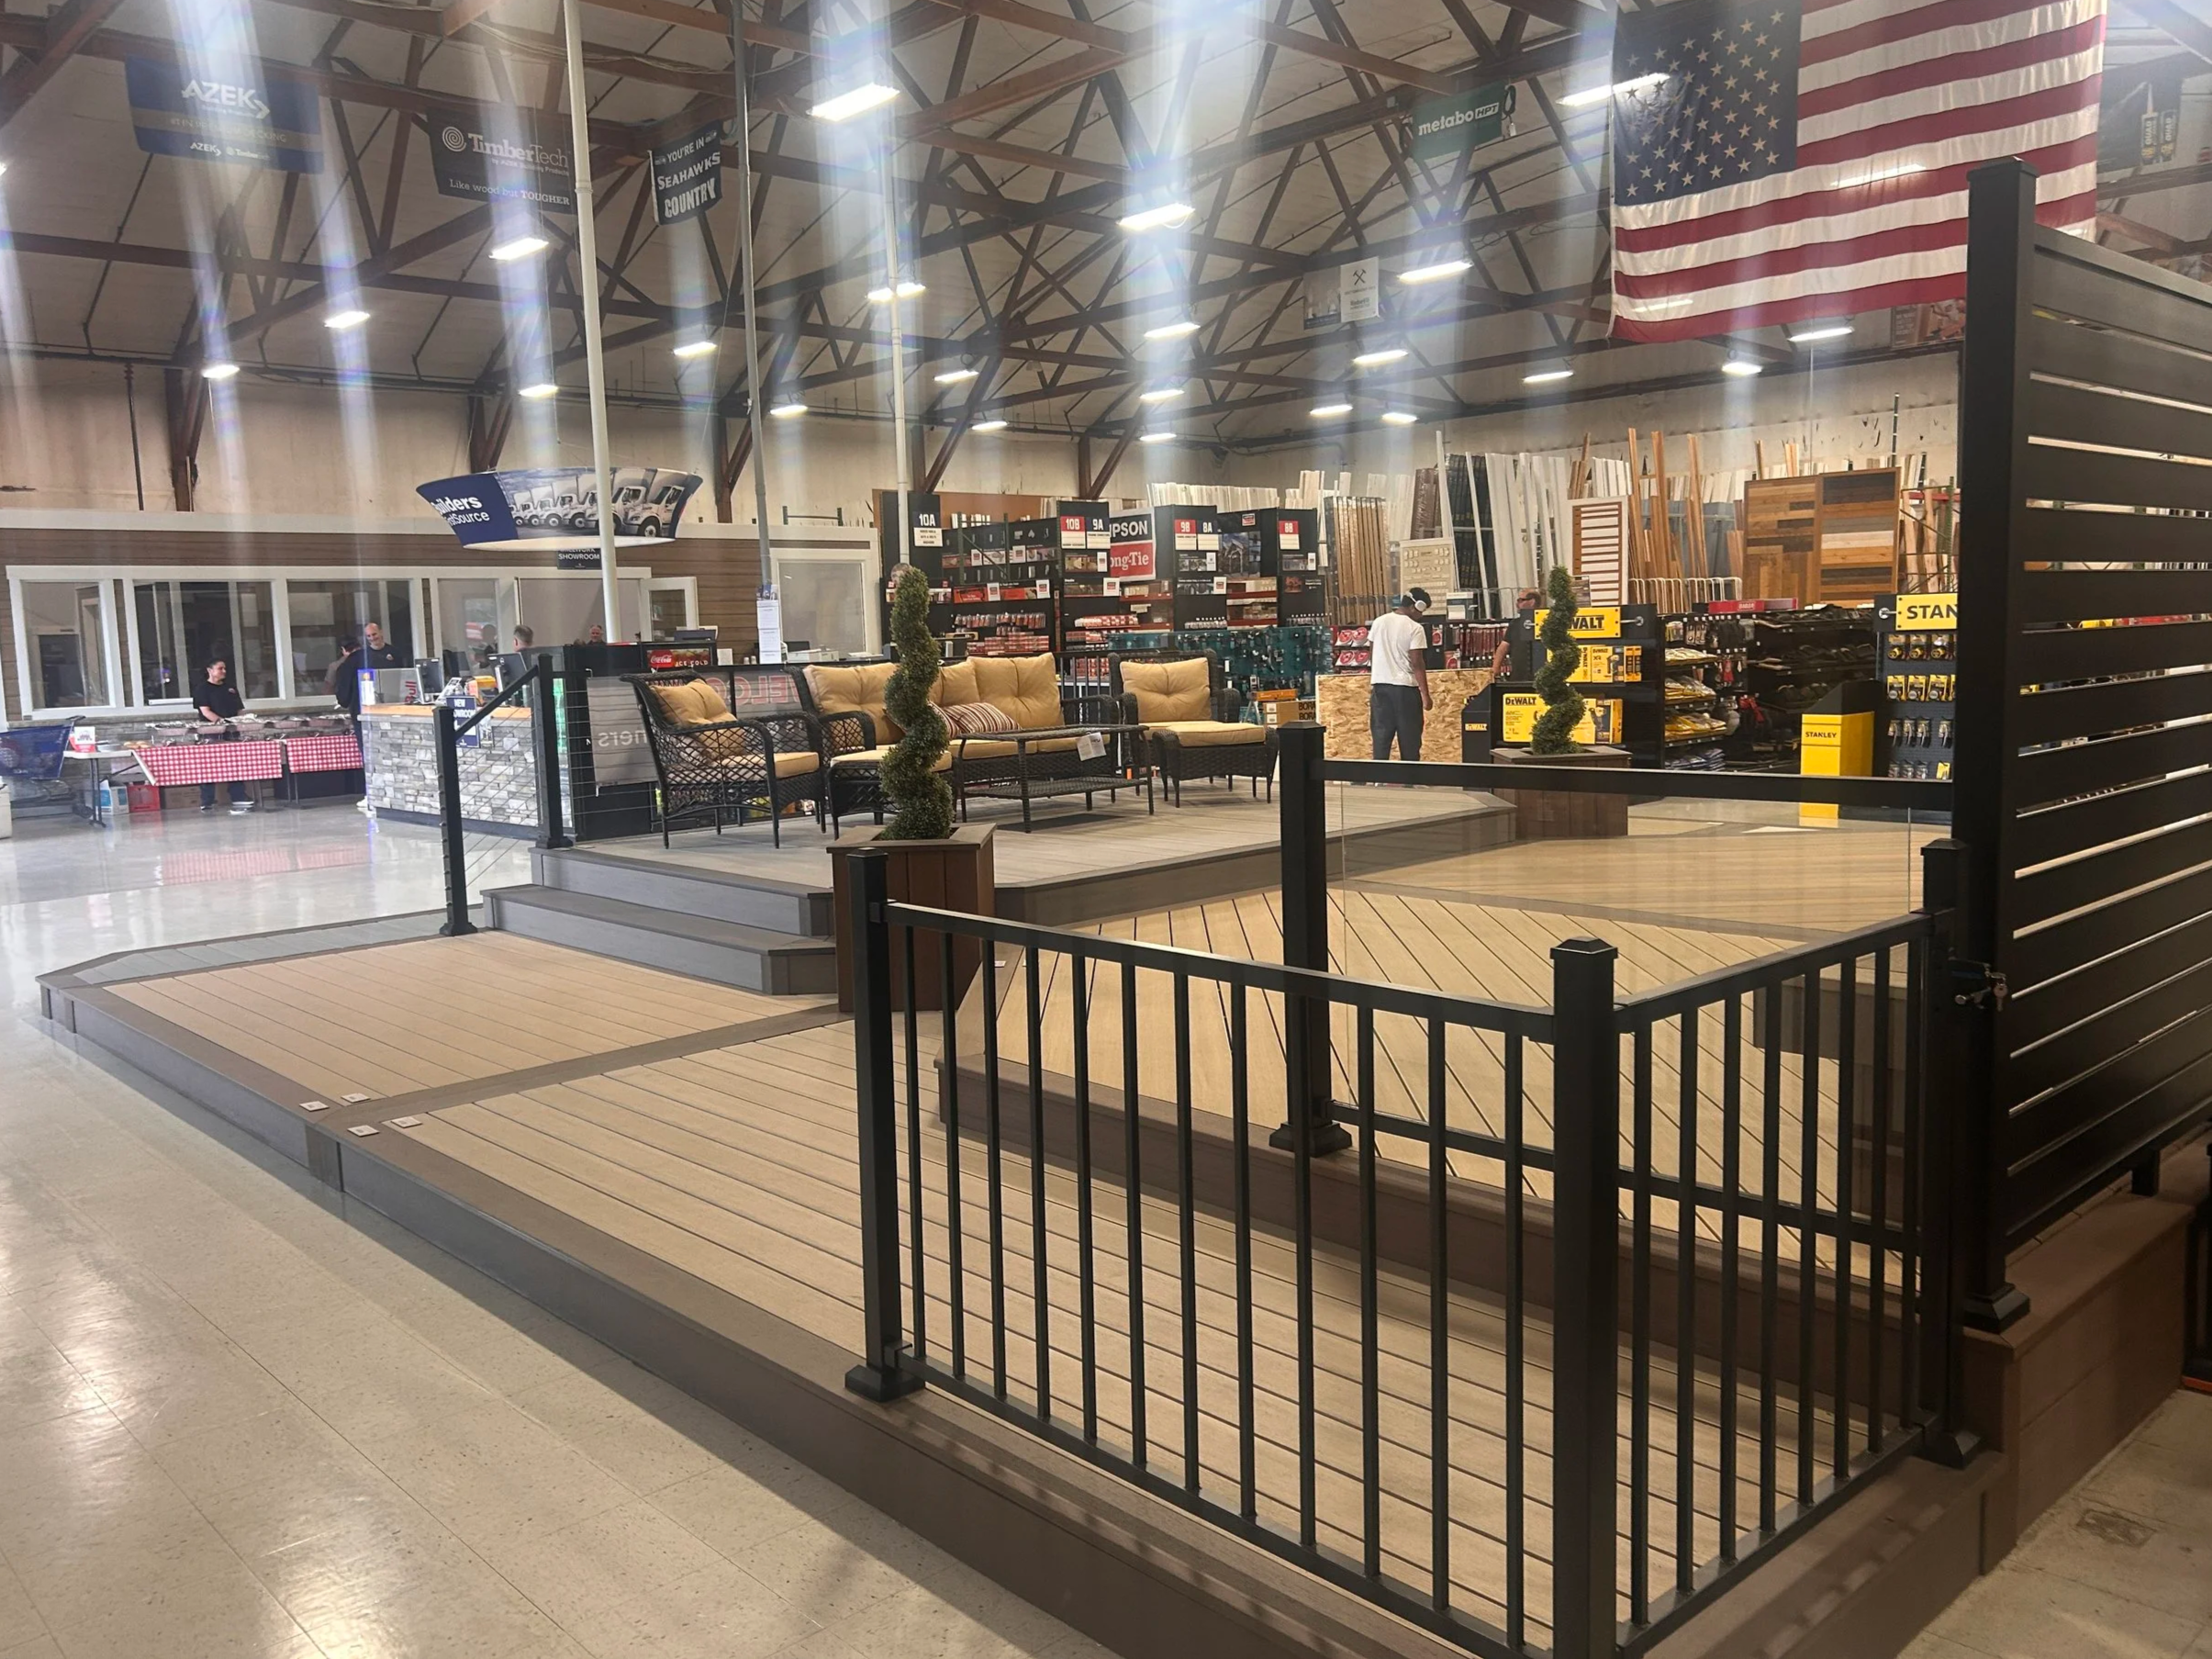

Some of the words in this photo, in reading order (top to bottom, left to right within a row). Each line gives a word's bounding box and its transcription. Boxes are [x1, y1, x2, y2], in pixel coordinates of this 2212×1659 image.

[182, 79, 265, 116] AZEK
[1418, 110, 1474, 136] metabo
[1476, 104, 1498, 118] HPT
[190, 142, 221, 155] AZEK
[468, 132, 569, 168] TimberTech
[667, 142, 695, 163] YOU'RE
[696, 137, 705, 150] IN
[657, 151, 721, 190] SEAHAWKS
[449, 178, 470, 191] Like
[473, 183, 499, 195] wood
[502, 186, 519, 197] but
[520, 190, 570, 205] TOUGHER
[665, 177, 716, 218] COUNTRY
[919, 514, 936, 526] 10A
[1066, 518, 1080, 531] 10B
[1092, 519, 1104, 531] 9A
[1180, 521, 1190, 532] 9B
[1202, 522, 1212, 532] 8A
[1109, 521, 1148, 538] PSON
[1906, 604, 1957, 620] STAN
[1570, 616, 1604, 630] WALT
[454, 699, 465, 707] NEW
[1505, 697, 1536, 706] DEWALT
